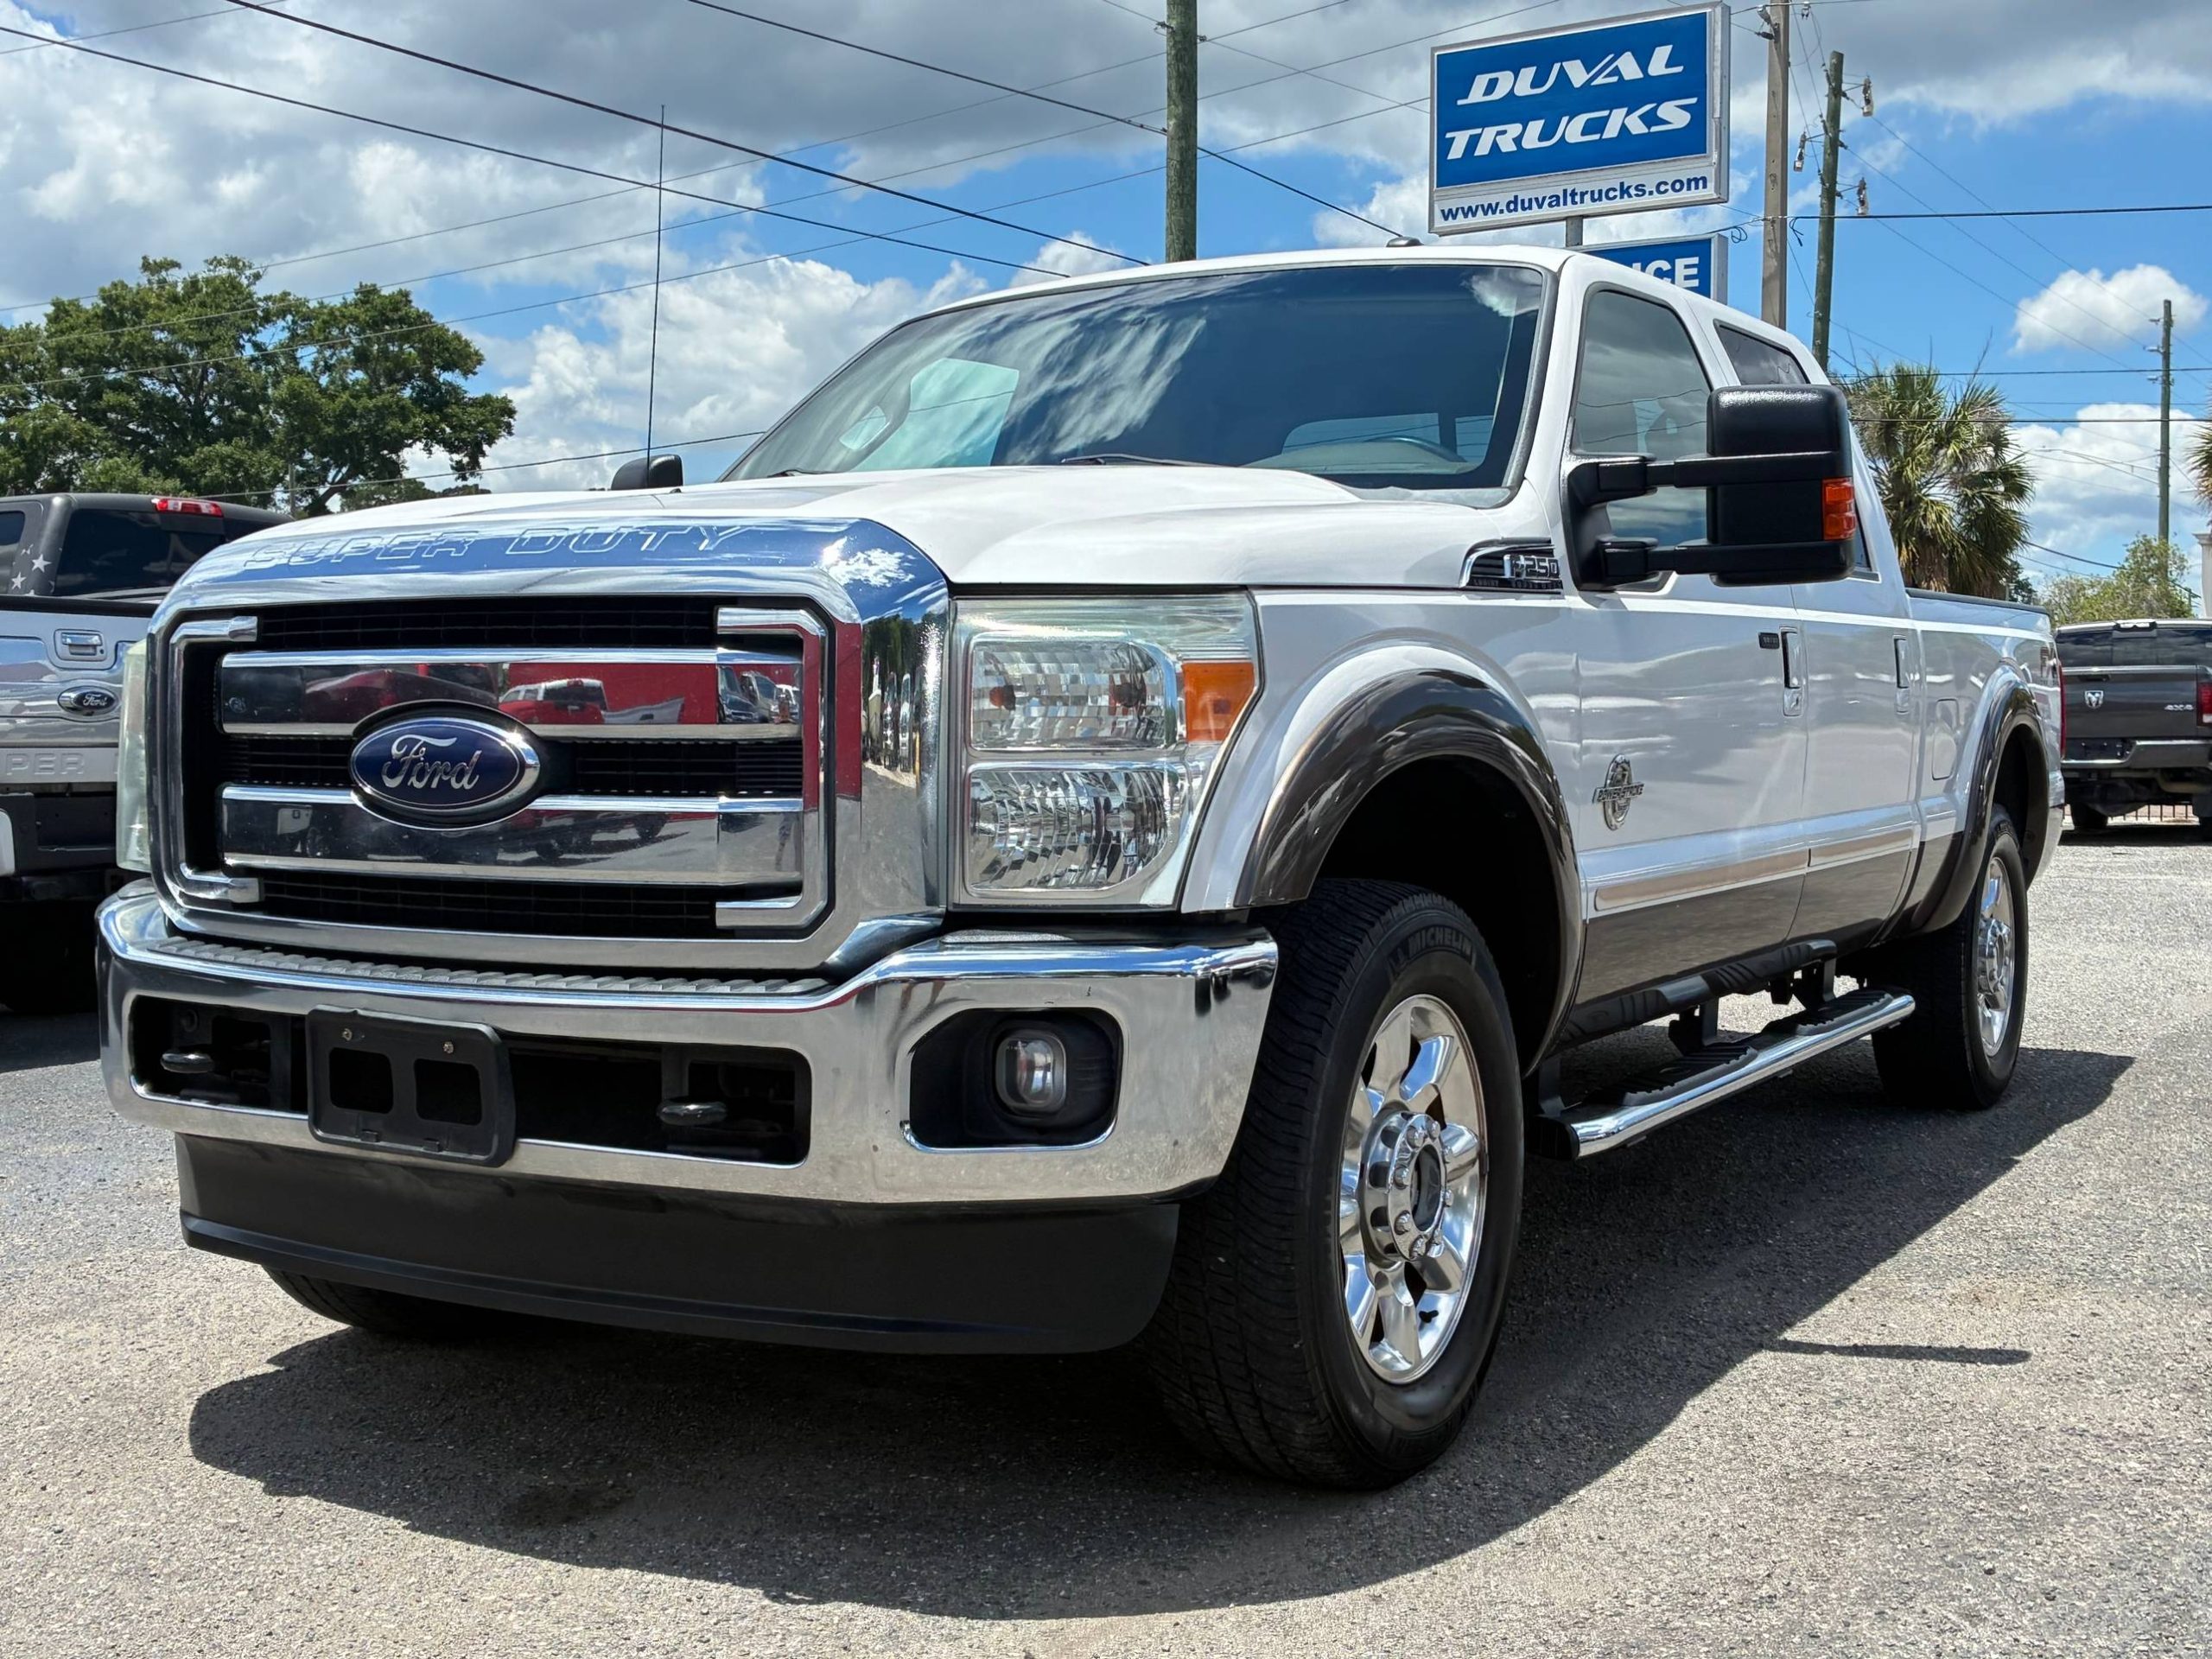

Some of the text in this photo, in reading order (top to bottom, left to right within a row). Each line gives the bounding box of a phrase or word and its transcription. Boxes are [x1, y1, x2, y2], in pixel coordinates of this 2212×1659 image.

[1457, 44, 1685, 106] DUVAL
[1445, 97, 1698, 161] TRUCKS
[1440, 175, 1708, 221] www.duvaltrucks.com
[244, 524, 750, 571] SUPER DUTY
[82, 693, 108, 707] Ford
[381, 734, 483, 791] Ford
[1408, 925, 1472, 960] MICHELIN
